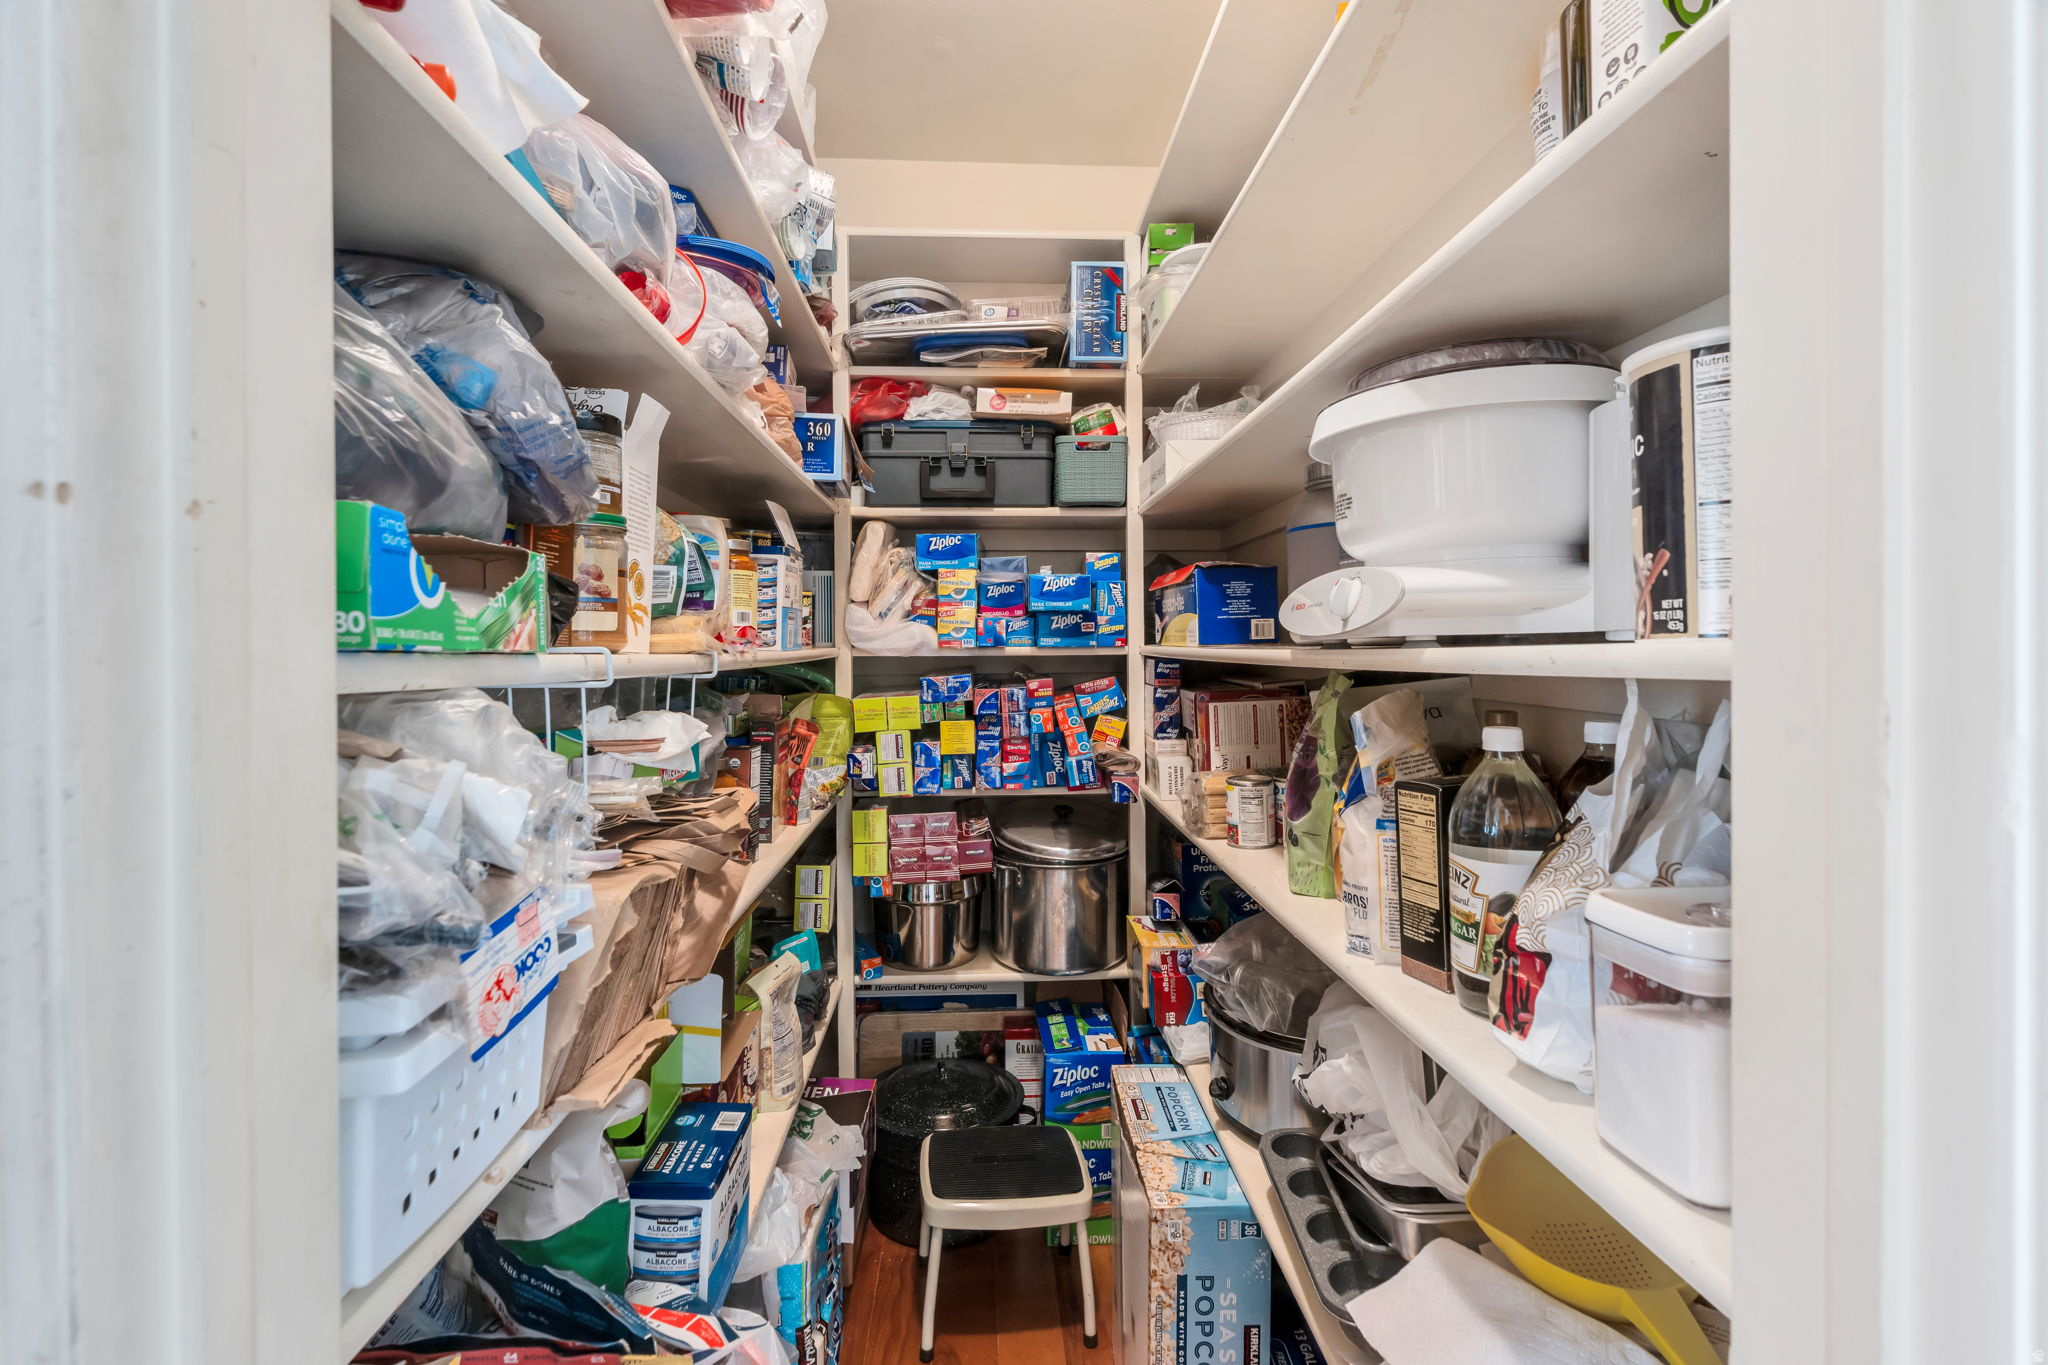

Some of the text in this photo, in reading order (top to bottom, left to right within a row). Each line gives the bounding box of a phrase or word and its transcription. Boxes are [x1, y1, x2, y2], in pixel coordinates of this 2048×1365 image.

[1092, 320, 1102, 353] CLEAR
[1696, 355, 1729, 368] Nutrit
[1696, 390, 1729, 402] Calorie
[807, 421, 831, 437] 360
[378, 516, 407, 531] simpl
[929, 535, 962, 551] Ziploc
[987, 584, 1016, 598] Ziploc
[1042, 576, 1077, 592] Ziploc
[1109, 582, 1125, 608] Ziploc
[538, 584, 546, 646] sandwich
[1051, 613, 1083, 629] Ziploc
[1007, 619, 1029, 633] Ziploc
[1081, 679, 1109, 690] Storage
[1107, 736, 1118, 744] 200
[1047, 741, 1064, 773] Ziploc
[955, 758, 971, 782] Ziploc
[1399, 791, 1435, 802] Nutrition Facts
[874, 982, 988, 993] Heartland Pottery Company
[1052, 1064, 1099, 1088] Ziploc
[1060, 1081, 1105, 1098] Easy Open Tabs
[1165, 1086, 1193, 1131] POPCORN
[661, 1140, 688, 1174] ALBACORE
[1098, 1172, 1112, 1182] Tab
[647, 1225, 689, 1233] ALBACORE
[1244, 1224, 1257, 1236] 36
[1195, 1275, 1215, 1365] POPC
[1250, 1327, 1259, 1365] KIRKLA
